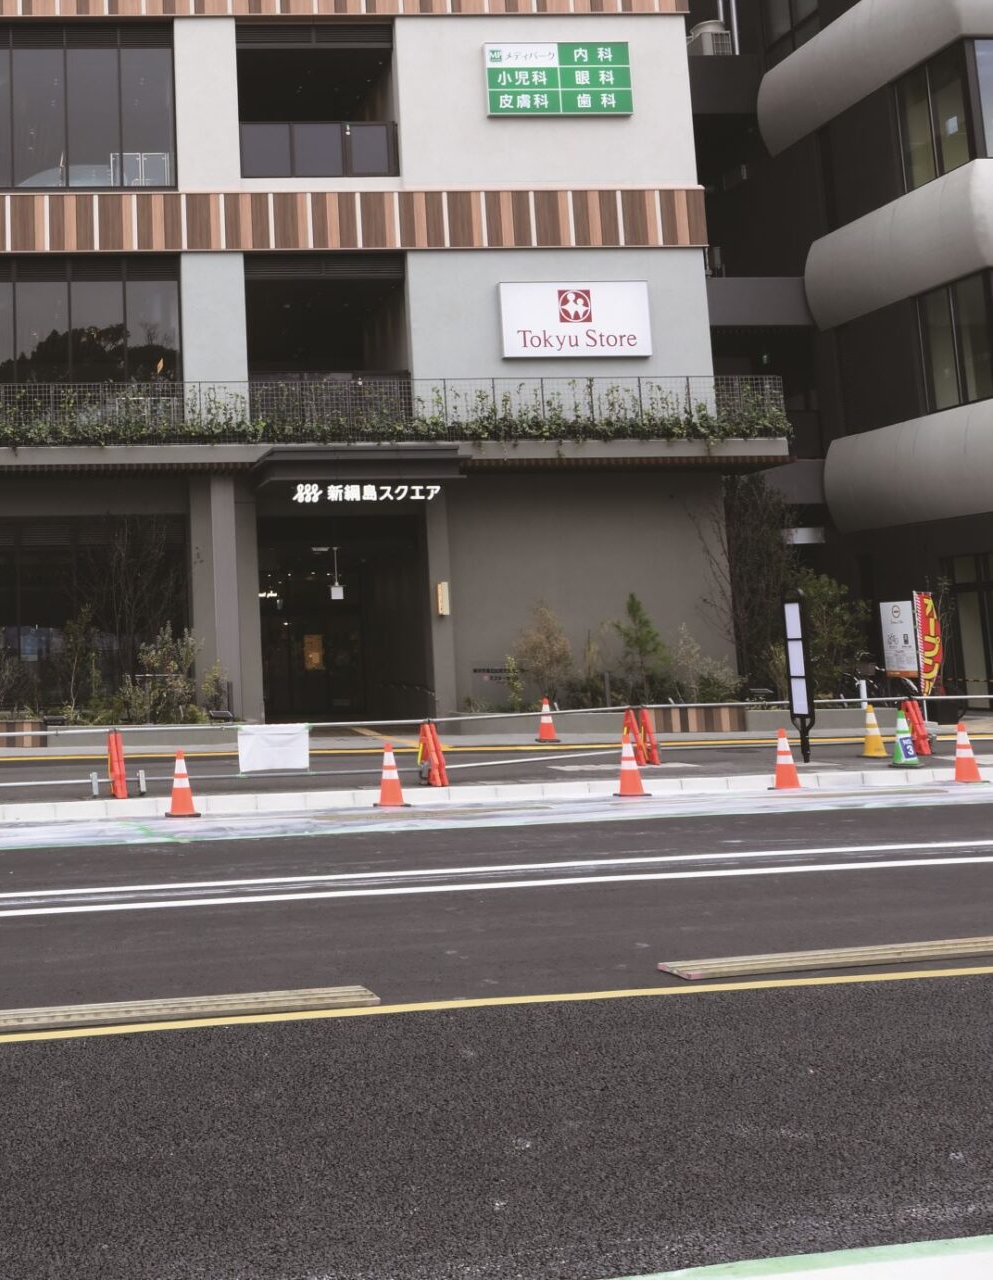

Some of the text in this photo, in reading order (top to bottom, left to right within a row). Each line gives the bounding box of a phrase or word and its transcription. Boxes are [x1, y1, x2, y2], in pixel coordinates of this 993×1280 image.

[573, 47, 613, 62] 内科
[497, 70, 547, 85] 小児科
[575, 70, 615, 85] 眼科
[499, 93, 549, 109] 皮膚科
[577, 93, 617, 108] 歯科
[517, 328, 638, 351] Tokyu Store
[327, 484, 441, 501] 新綱島スクエア
[906, 744, 914, 756] 3
